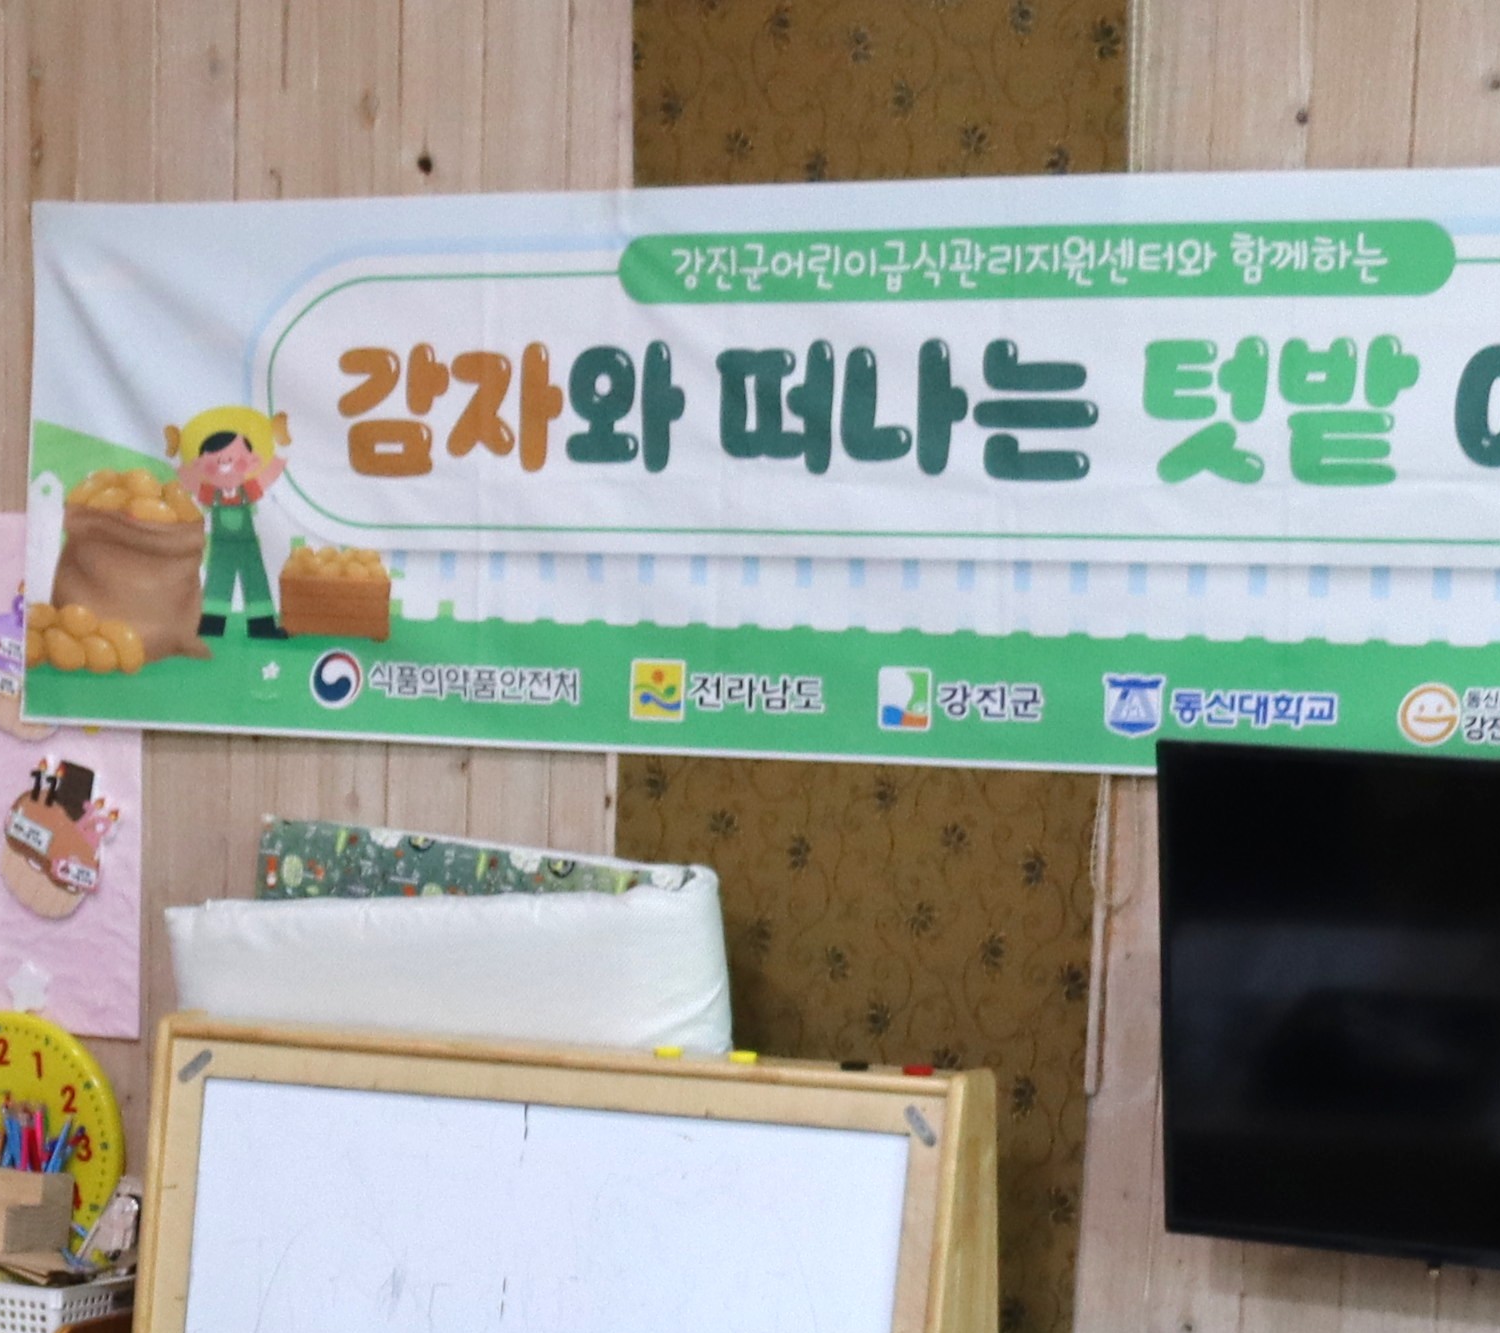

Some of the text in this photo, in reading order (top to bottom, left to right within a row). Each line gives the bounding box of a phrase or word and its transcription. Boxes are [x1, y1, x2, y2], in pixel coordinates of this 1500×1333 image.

[673, 232, 1389, 293] 강진군어린이급식관리지원센터와 함께하는
[337, 339, 685, 479] 감자와
[717, 338, 1099, 482] 떠나는
[1142, 333, 1420, 486] 텃밭
[369, 662, 580, 703] 식품의약품안전처
[690, 674, 824, 713] 전라남도
[939, 684, 1042, 720] 강진군
[1172, 690, 1336, 727] 동신대학교
[32, 1051, 43, 1079] 1
[60, 1085, 77, 1113] 2
